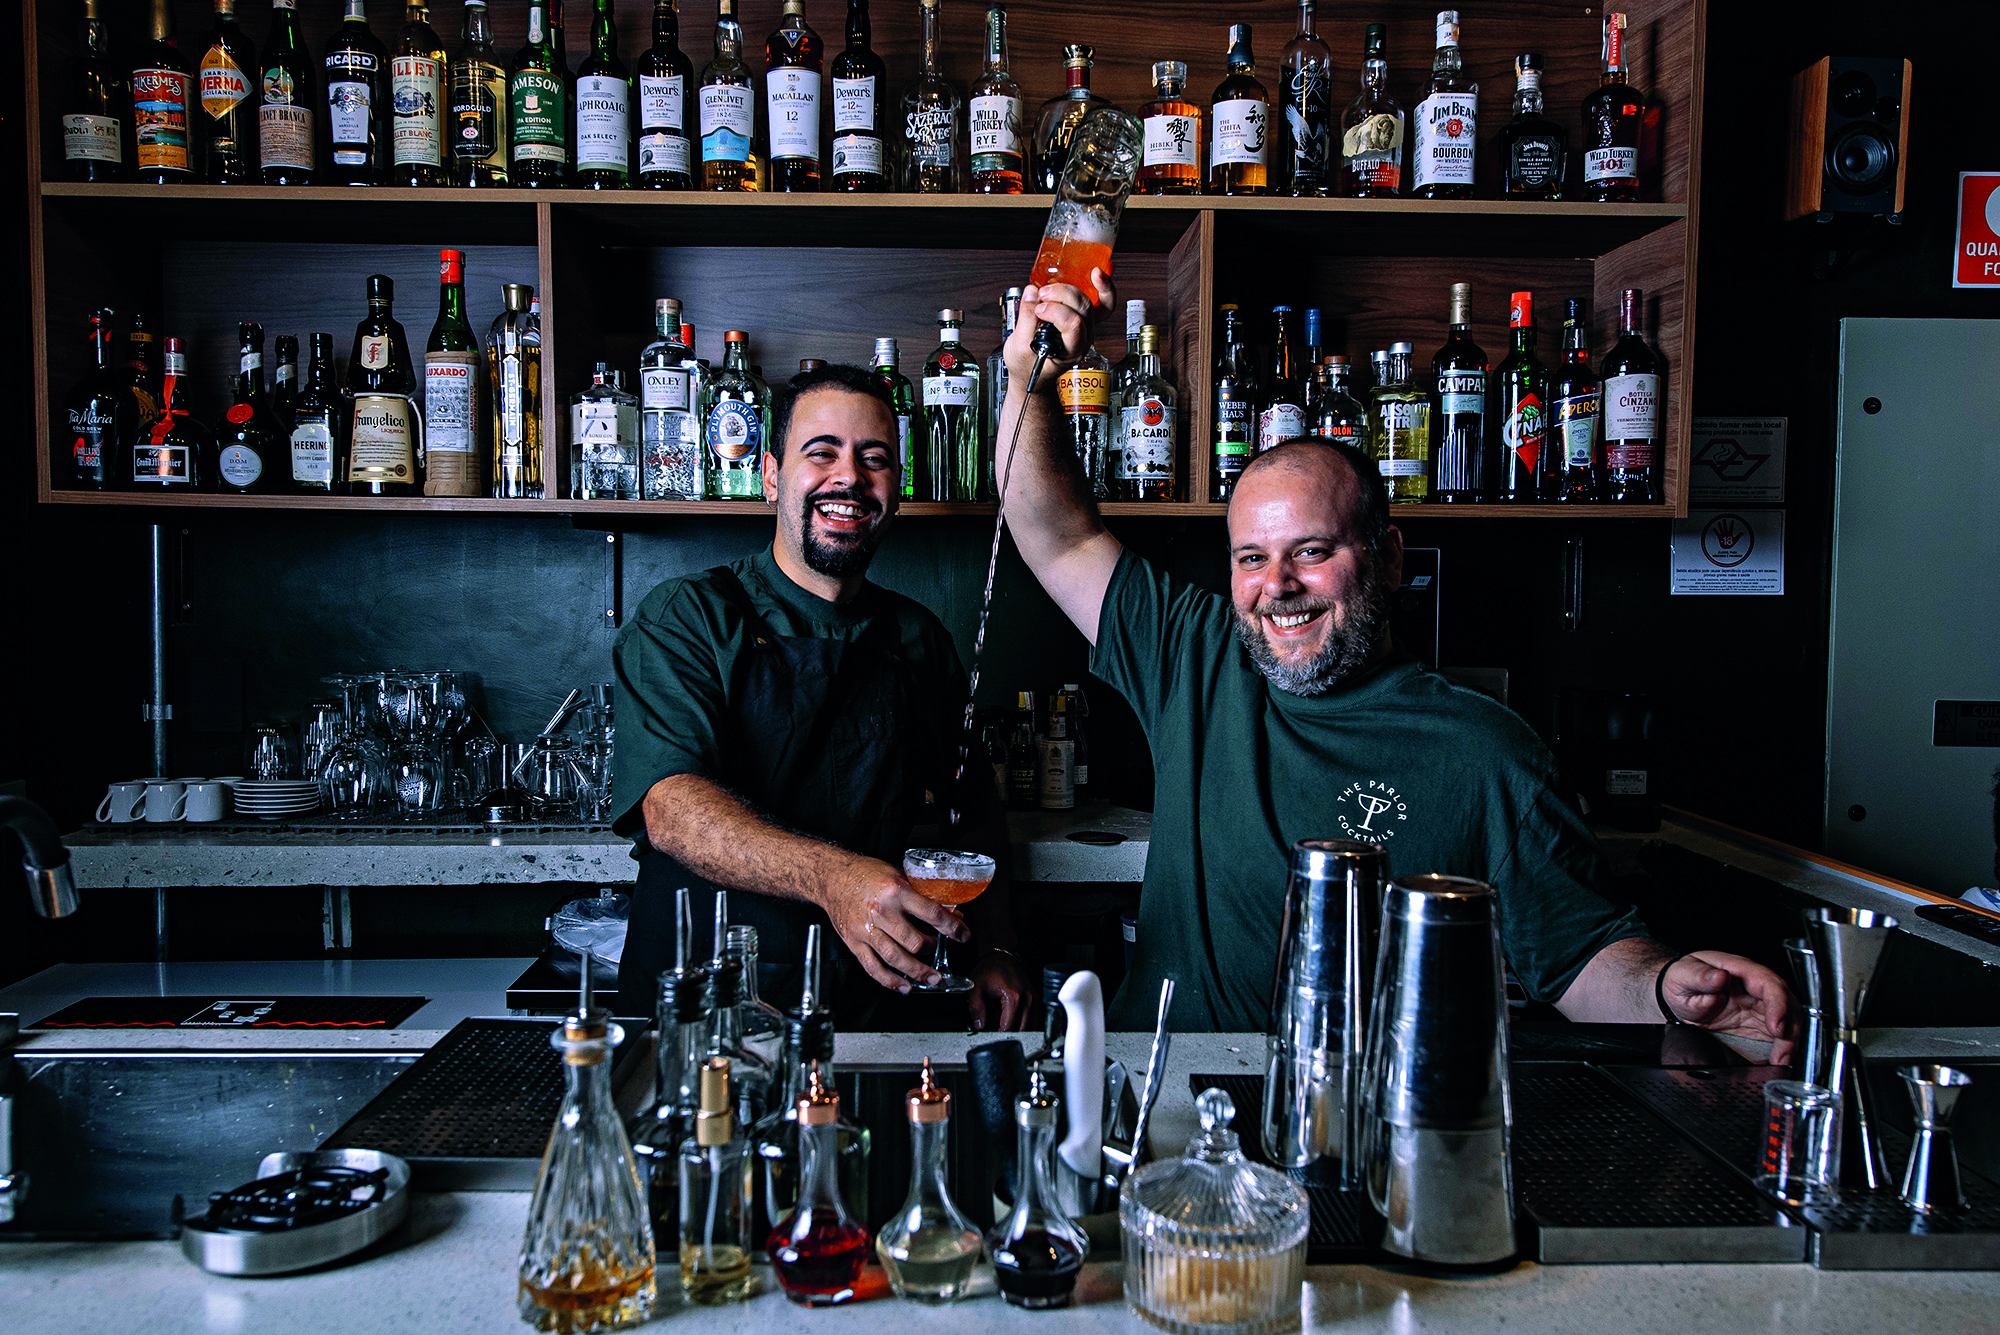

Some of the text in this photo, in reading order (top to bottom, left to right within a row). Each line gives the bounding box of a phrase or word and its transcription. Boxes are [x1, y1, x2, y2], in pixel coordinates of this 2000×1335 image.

[326, 54, 373, 67] RICARD
[512, 76, 560, 95] JAMESON
[643, 84, 679, 96] Dewar's
[772, 93, 814, 102] MACALLAN
[836, 88, 871, 99] Dewar's
[655, 99, 664, 107] 12
[705, 96, 744, 106] GLENLIVET
[848, 101, 856, 110] 12
[577, 100, 626, 114] APHROAIG
[279, 110, 306, 123] BRANCA
[786, 111, 798, 120] 12
[976, 110, 998, 120] WILD
[1430, 106, 1450, 124] JIM
[972, 120, 1003, 132] TURKEY
[1220, 124, 1241, 132] CHITA
[408, 130, 433, 138] BLANC
[976, 135, 997, 145] RYE
[1433, 148, 1473, 158] BOURBON
[1590, 149, 1634, 161] WILD TURKEY
[1352, 159, 1380, 172] BUFFALO
[1599, 159, 1624, 171] 101
[426, 368, 467, 376] LUXARDO
[648, 376, 681, 385] OXLEY
[1060, 378, 1104, 388] BARSOL
[944, 386, 967, 394] TEN
[68, 408, 112, 425] Tia Maria
[354, 409, 405, 429] Frangelico
[711, 403, 749, 432] PLYMOUTH
[747, 416, 757, 432] GIN
[1222, 410, 1244, 418] HAUS
[1131, 426, 1171, 438] BACARDÍ
[1320, 425, 1352, 436] ESPOLÓN
[1337, 780, 1407, 820] THE PARLOR
[1338, 815, 1394, 842] COCKTAILS
